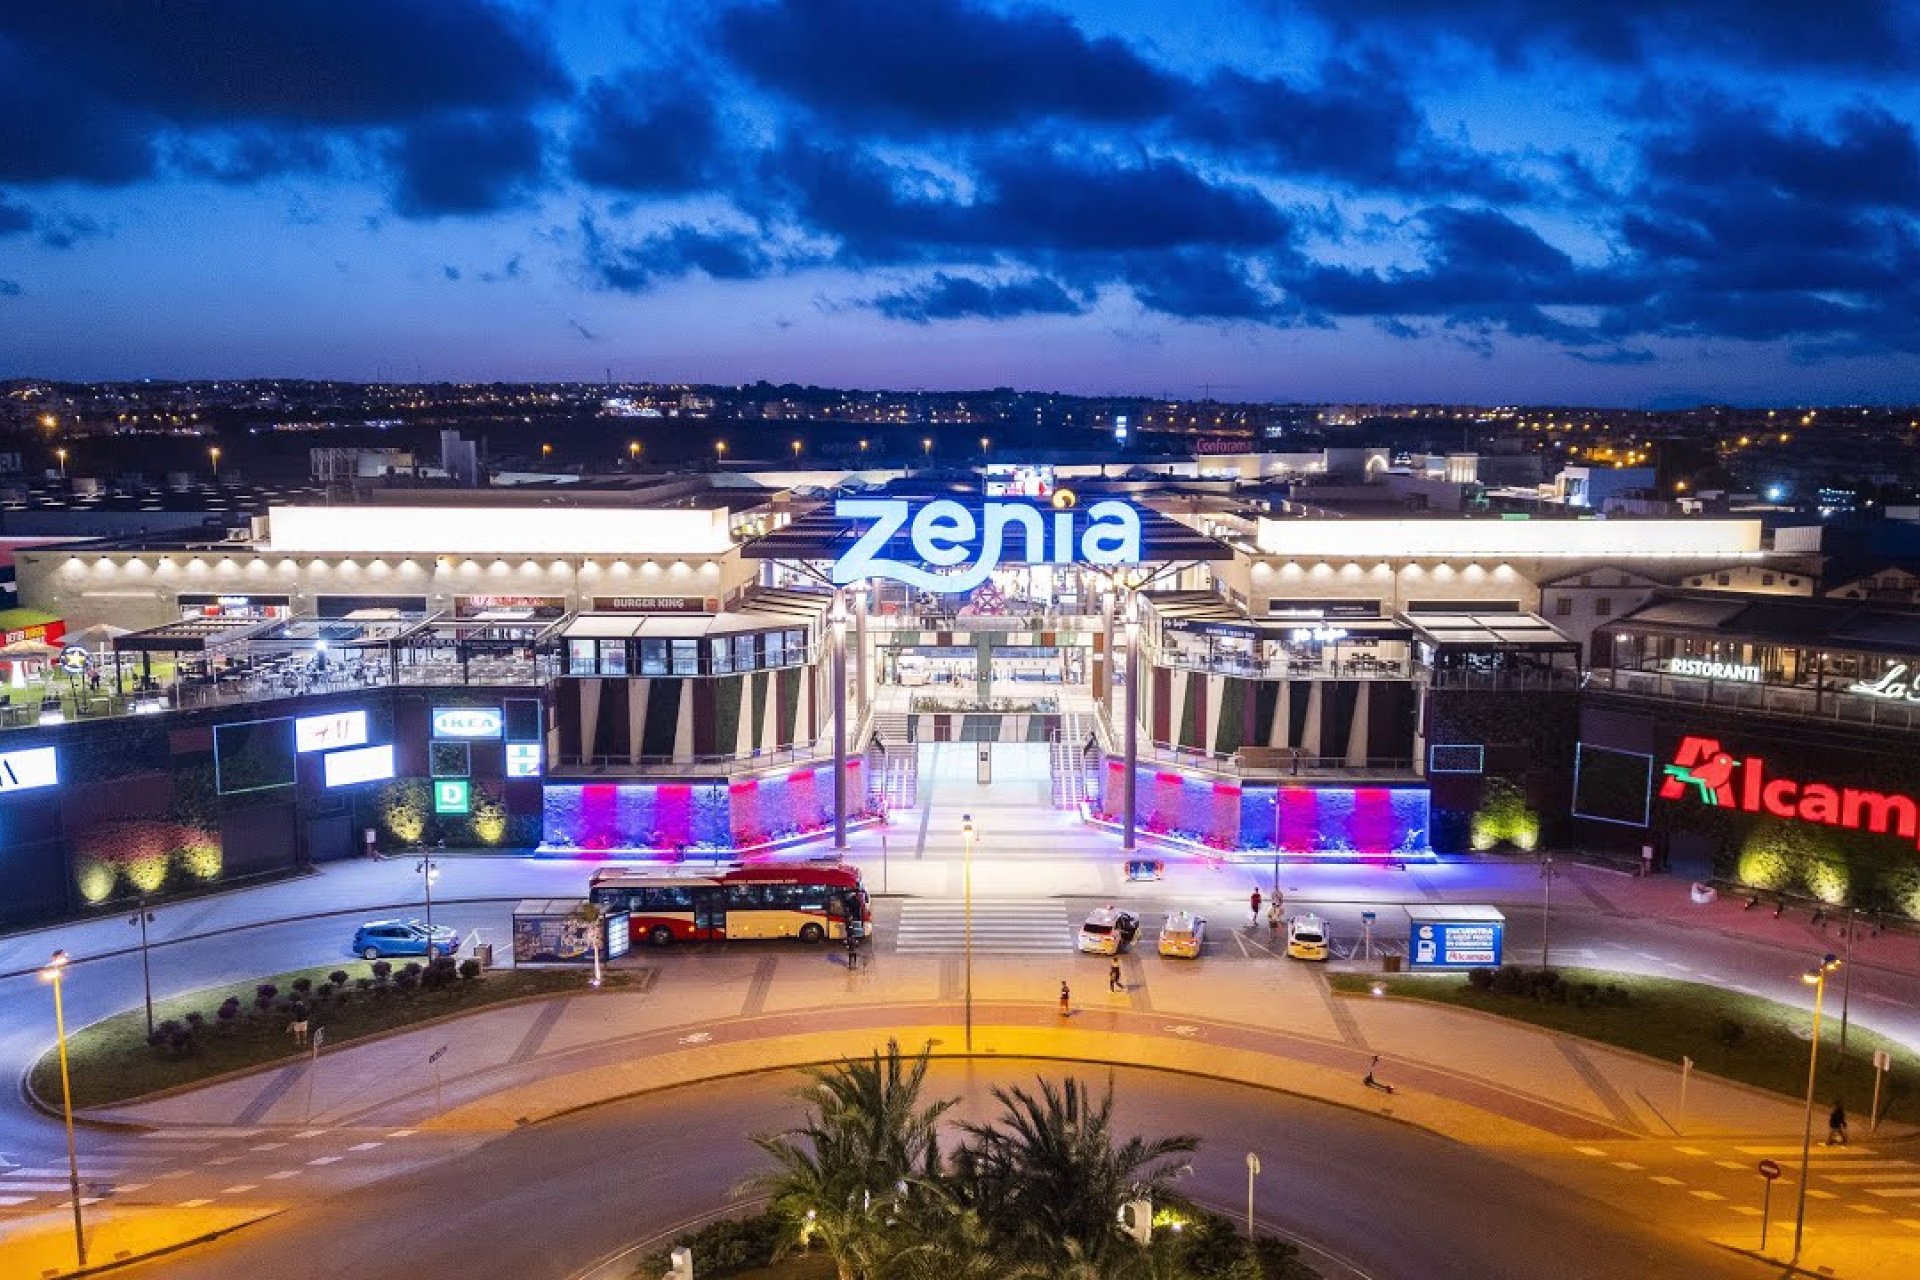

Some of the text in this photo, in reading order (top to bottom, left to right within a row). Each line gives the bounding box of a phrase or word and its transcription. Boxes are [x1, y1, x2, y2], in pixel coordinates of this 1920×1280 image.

[1197, 437, 1252, 453] Conforama
[613, 598, 685, 609] BURGER KING
[441, 718, 494, 728] IKEA
[1659, 736, 1920, 852] Alcam
